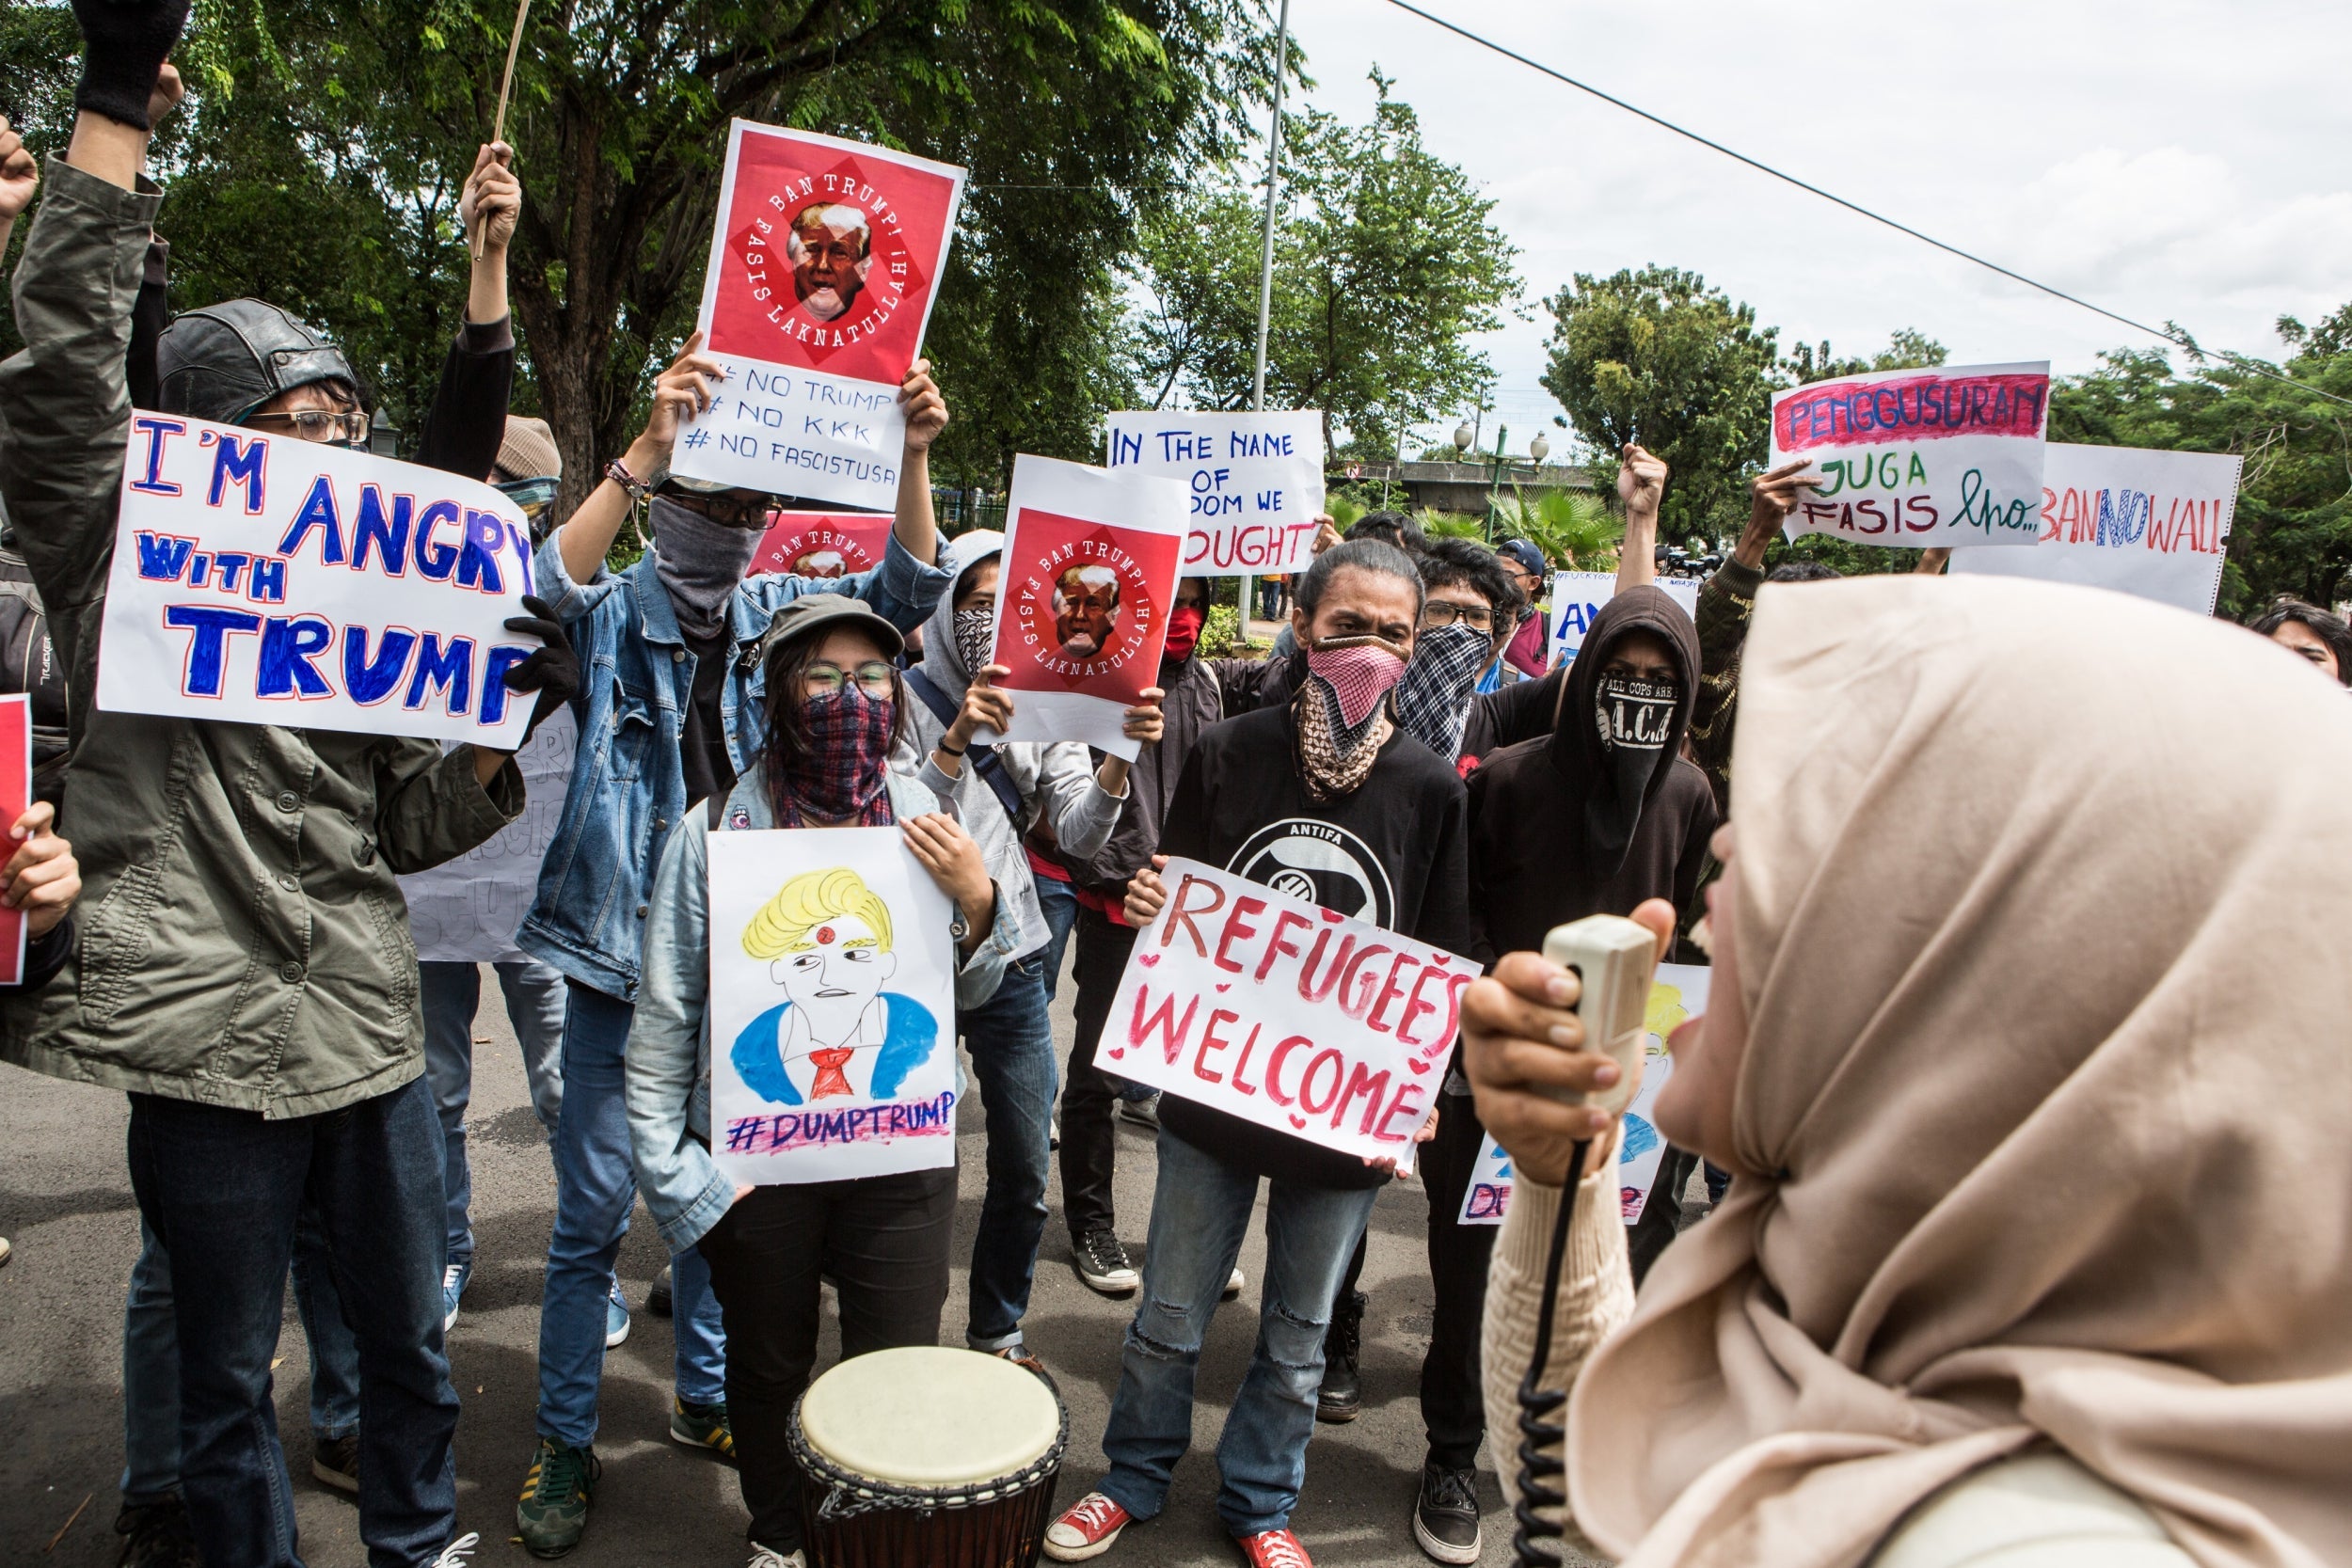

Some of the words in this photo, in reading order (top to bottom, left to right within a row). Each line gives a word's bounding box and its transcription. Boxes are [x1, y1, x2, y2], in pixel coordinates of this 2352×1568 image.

[769, 176, 814, 213] BAN
[824, 173, 903, 237] TRUMP!
[746, 216, 772, 302] FASIS
[767, 249, 908, 348] LAKNATULLAH!
[737, 401, 783, 428] NO
[746, 369, 791, 397] NO
[804, 381, 892, 412] TRUMP
[1789, 382, 2043, 443] PENGGUSURAN
[720, 433, 758, 459] NO
[1111, 427, 1142, 467] IN
[1156, 430, 1213, 463] THE
[1230, 430, 1295, 459] NAME
[1191, 468, 1231, 493] OF
[1809, 450, 1928, 498] JUGA
[130, 416, 269, 516] I'M
[278, 473, 535, 597] ANGRY
[1190, 495, 1243, 517] DOM
[1257, 490, 1283, 513] WE
[1802, 495, 1939, 535] FASIS
[134, 529, 290, 605] WITH
[772, 535, 803, 563] BAN
[808, 531, 871, 565] TRUMP!
[1039, 543, 1075, 573] BAN
[1082, 540, 1148, 590] TRUMP!
[1184, 522, 1315, 569] OUGHT
[1019, 576, 1041, 646] FASIS
[1034, 597, 1151, 676] LAKNATULLAH!
[163, 604, 542, 726] TRUMP
[1606, 678, 1626, 694] ALL
[1629, 681, 1652, 697] COPS
[1655, 684, 1673, 698] ARE
[1289, 822, 1343, 847] ANTIFA
[1160, 874, 1475, 1059] REFUGEES
[1128, 983, 1427, 1144] WELCOME
[724, 1091, 956, 1151] #DUMPTRUMP
